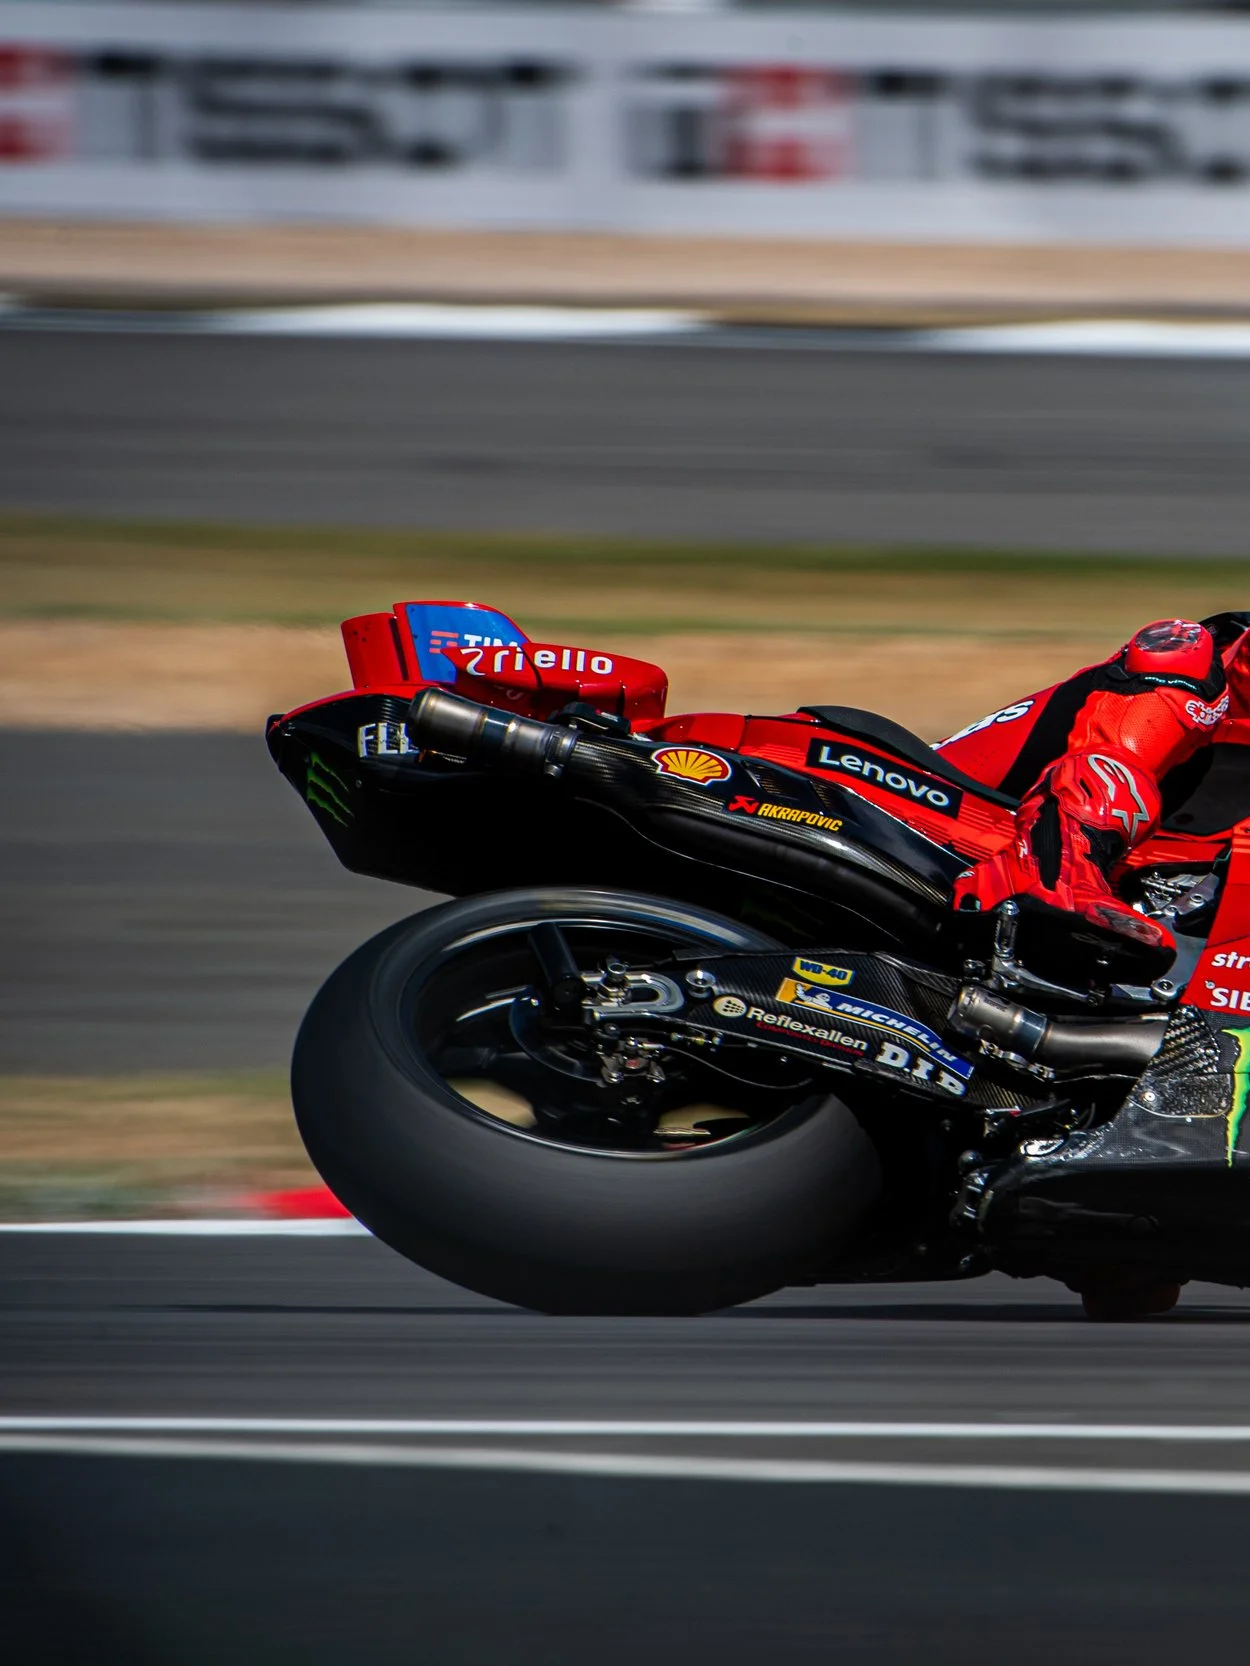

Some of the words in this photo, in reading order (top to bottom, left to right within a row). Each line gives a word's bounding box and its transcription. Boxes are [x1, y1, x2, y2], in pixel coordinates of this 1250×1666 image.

[818, 746, 950, 807] Lenovo
[799, 960, 848, 981] WD-40
[746, 1006, 869, 1051] Reflexallen
[836, 1002, 959, 1063] MICHELIN
